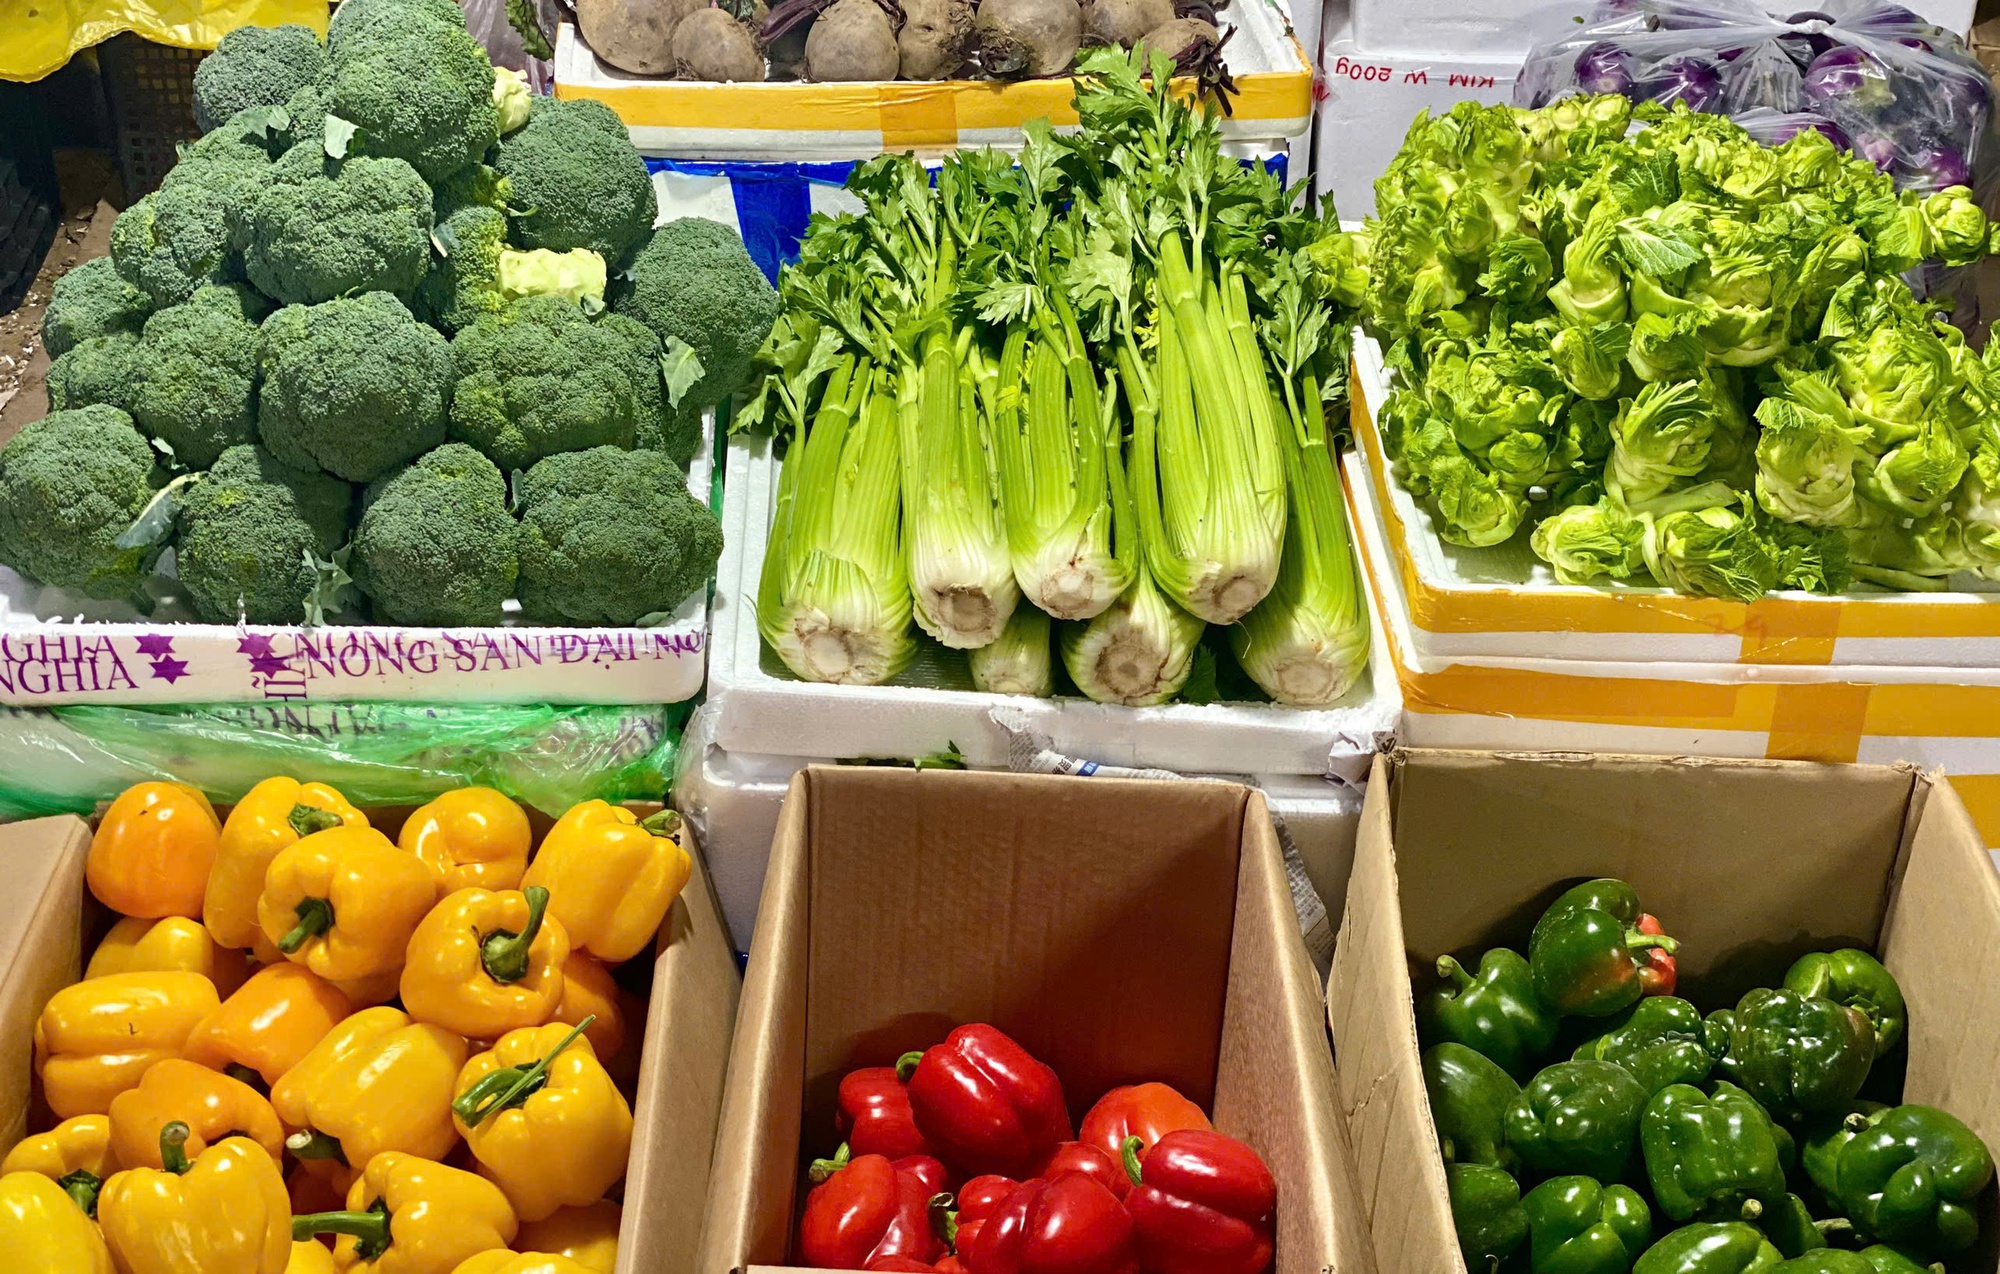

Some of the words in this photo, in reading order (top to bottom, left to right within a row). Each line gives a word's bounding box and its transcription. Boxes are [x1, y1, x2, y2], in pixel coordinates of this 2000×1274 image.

[1335, 56, 1393, 82] 200g
[1404, 69, 1428, 85] W
[1448, 73, 1495, 88] KIM
